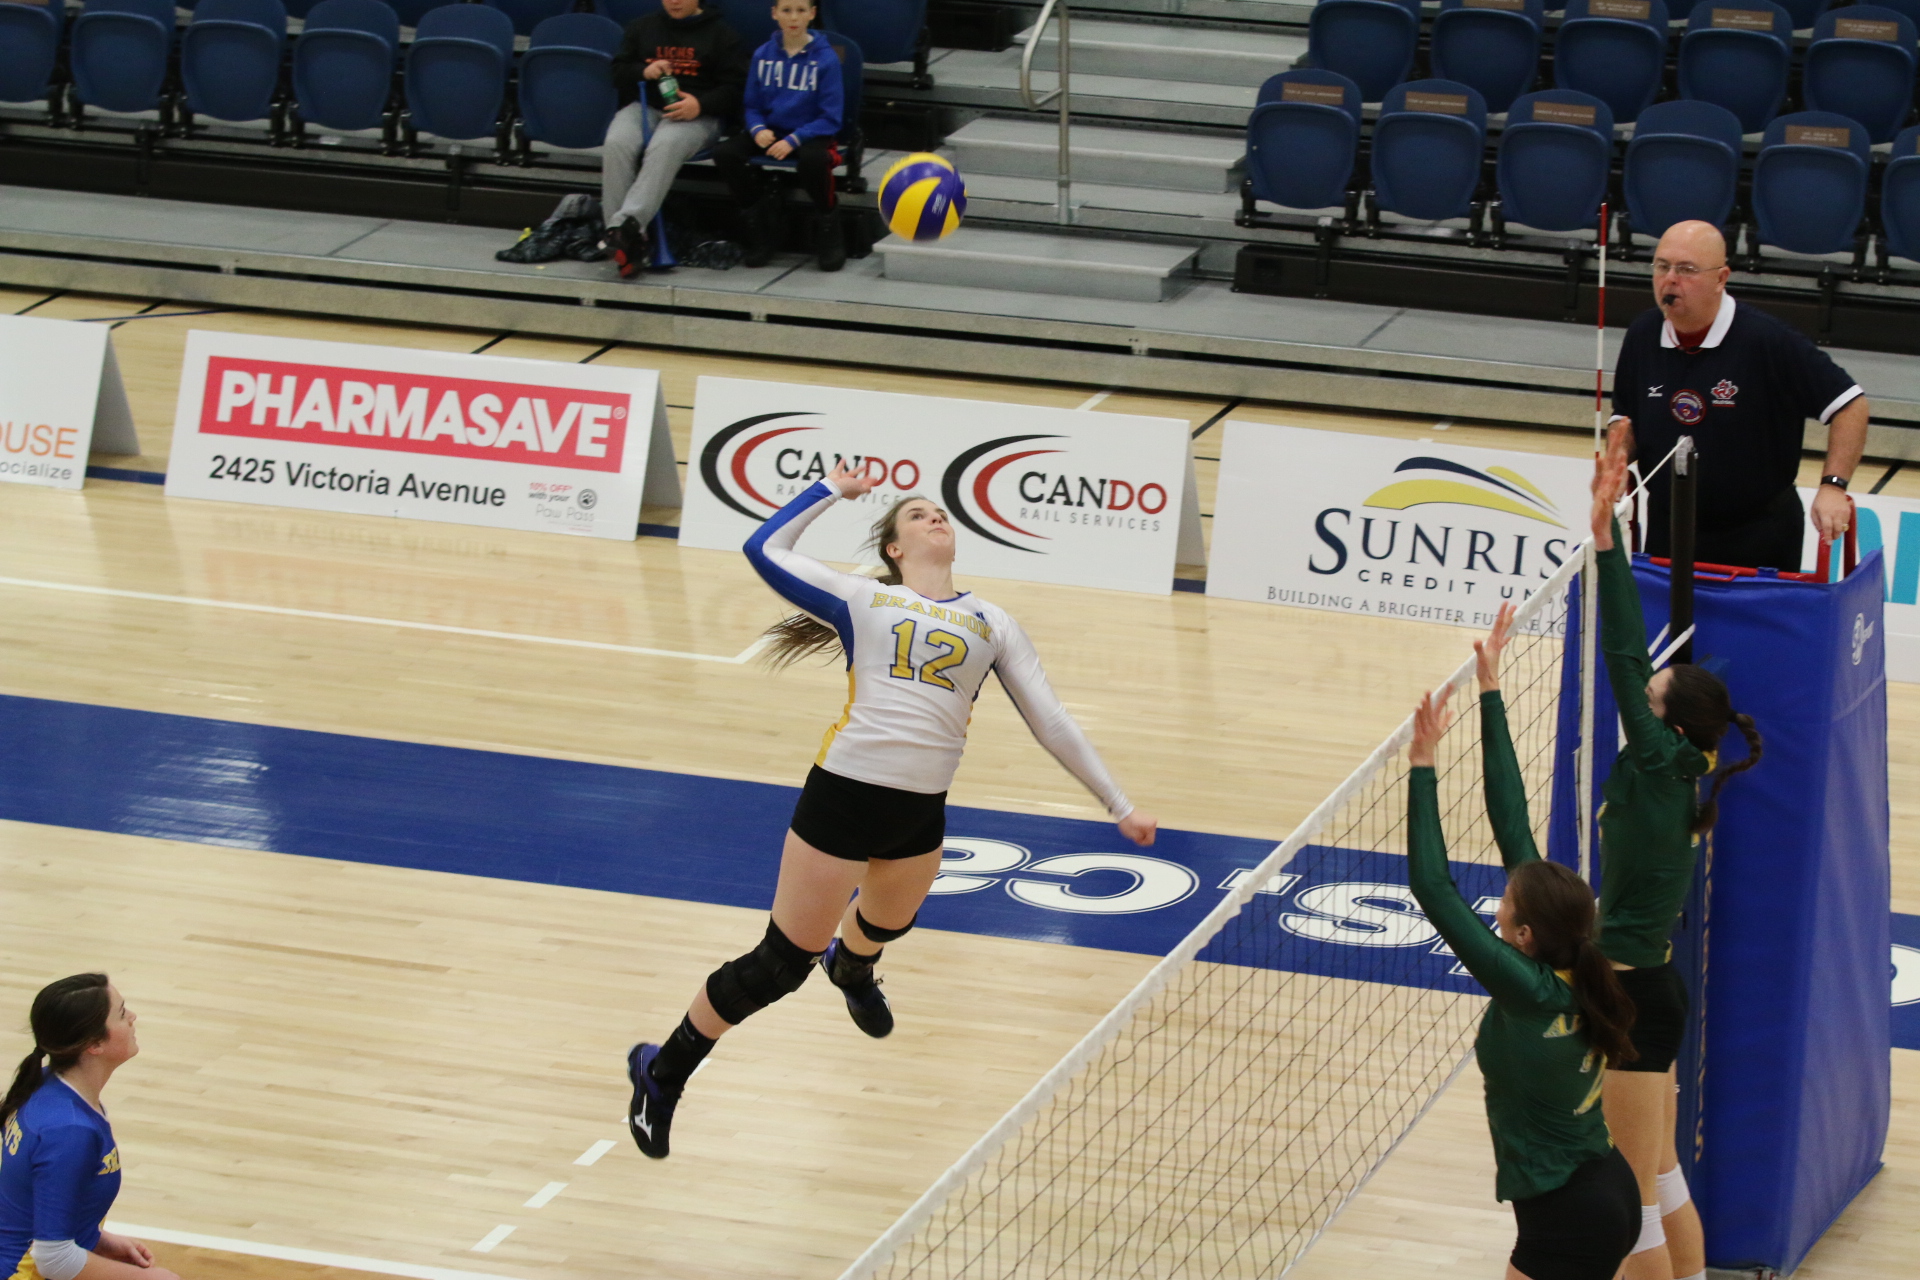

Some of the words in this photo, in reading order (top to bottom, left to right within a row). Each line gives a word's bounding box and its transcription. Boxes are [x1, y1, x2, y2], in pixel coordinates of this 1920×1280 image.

[216, 370, 613, 458] PHARMASAVE
[0, 420, 79, 460] USE
[209, 454, 276, 484] 2425
[286, 461, 391, 495] Victoria
[397, 472, 507, 507] Avenue
[548, 495, 571, 503] your
[1019, 471, 1168, 515] CANDO
[1020, 507, 1061, 523] RAIL
[1069, 511, 1161, 532] SERVICES
[1307, 507, 1568, 580] SUNRIS
[1357, 569, 1476, 595] CREDIT
[870, 592, 992, 643] BRANDON
[1267, 586, 1353, 609] BUILDING
[1359, 599, 1370, 612] A
[1378, 600, 1465, 623] BRIGHTER
[889, 618, 969, 692] 12
